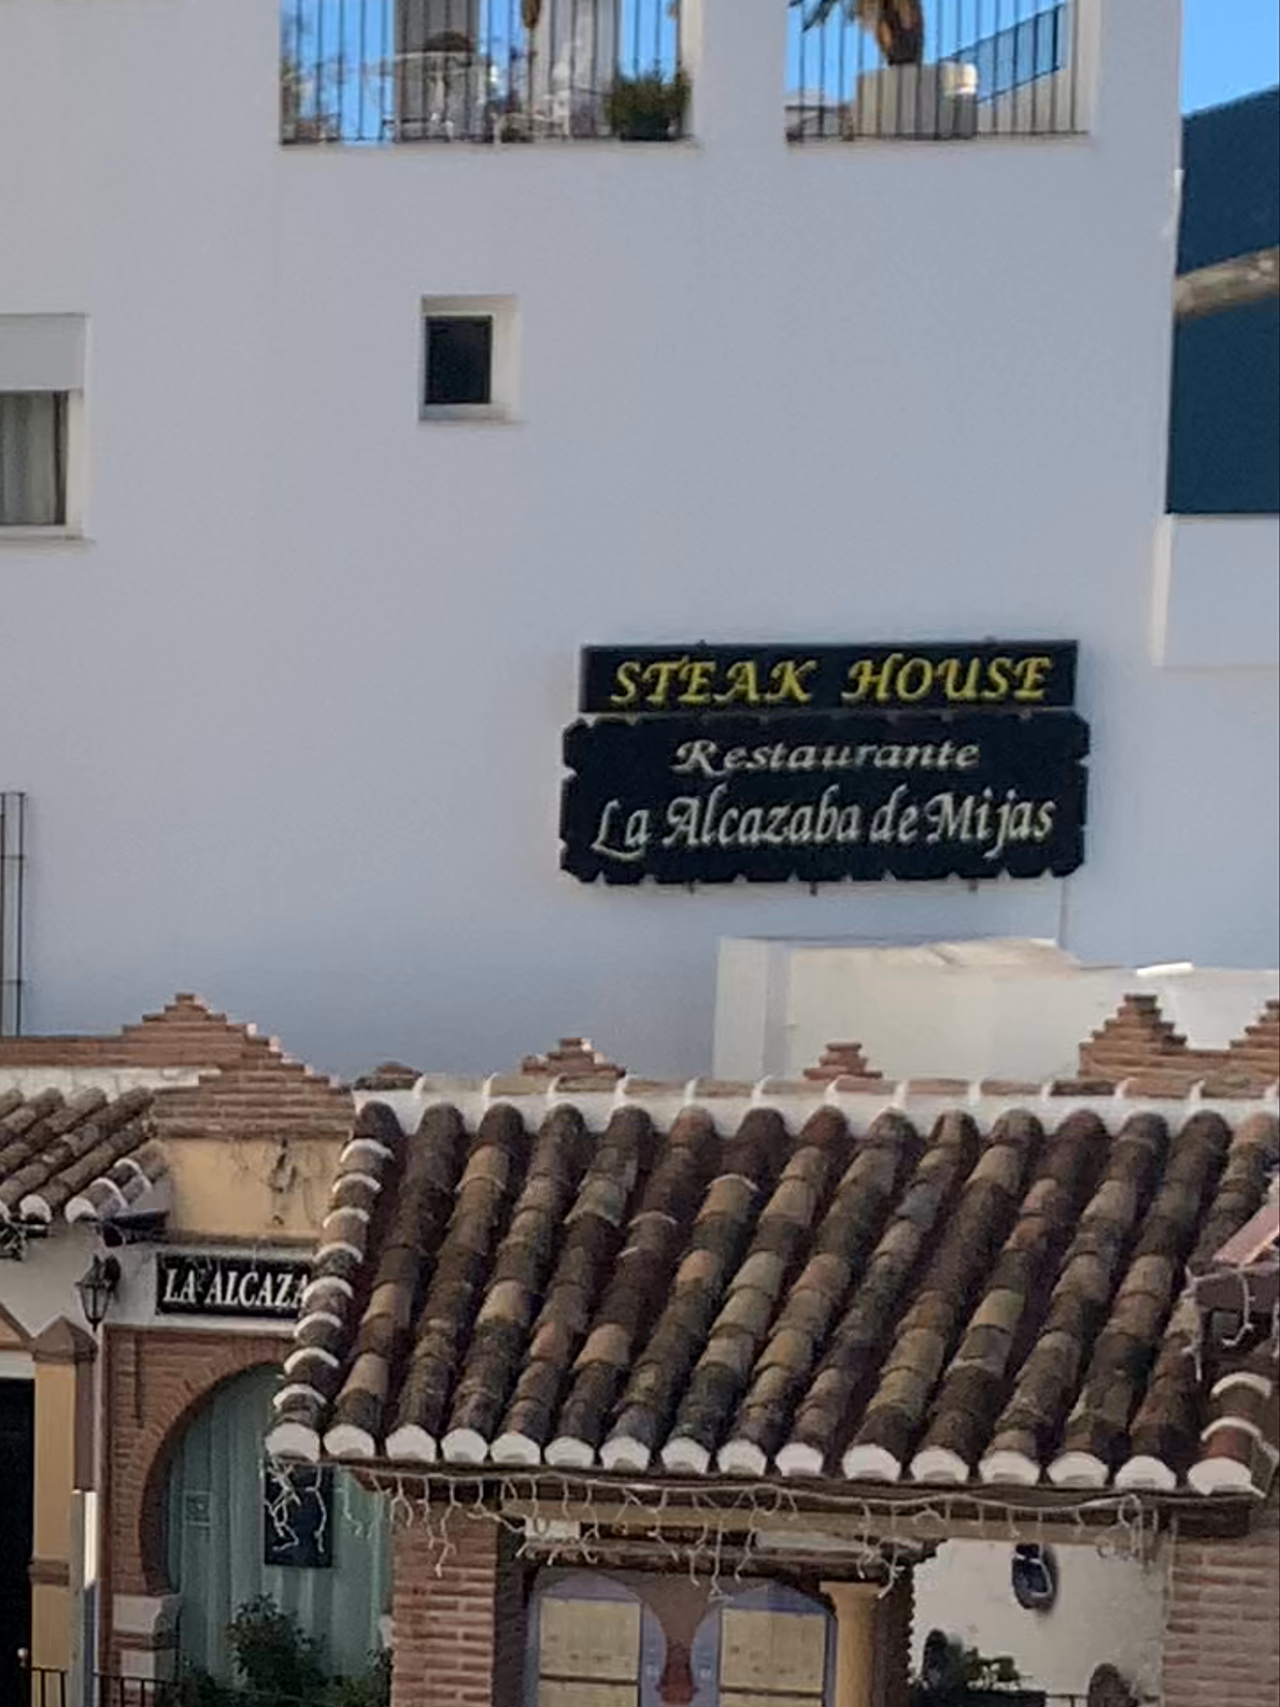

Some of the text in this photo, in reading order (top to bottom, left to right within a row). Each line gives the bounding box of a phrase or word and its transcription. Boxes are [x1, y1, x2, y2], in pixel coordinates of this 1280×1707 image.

[610, 653, 1053, 706] STEAK HOUSE
[669, 738, 981, 778] Restaurante
[591, 783, 1057, 862] La Alcazaba de Mijas
[162, 1268, 197, 1303] LA
